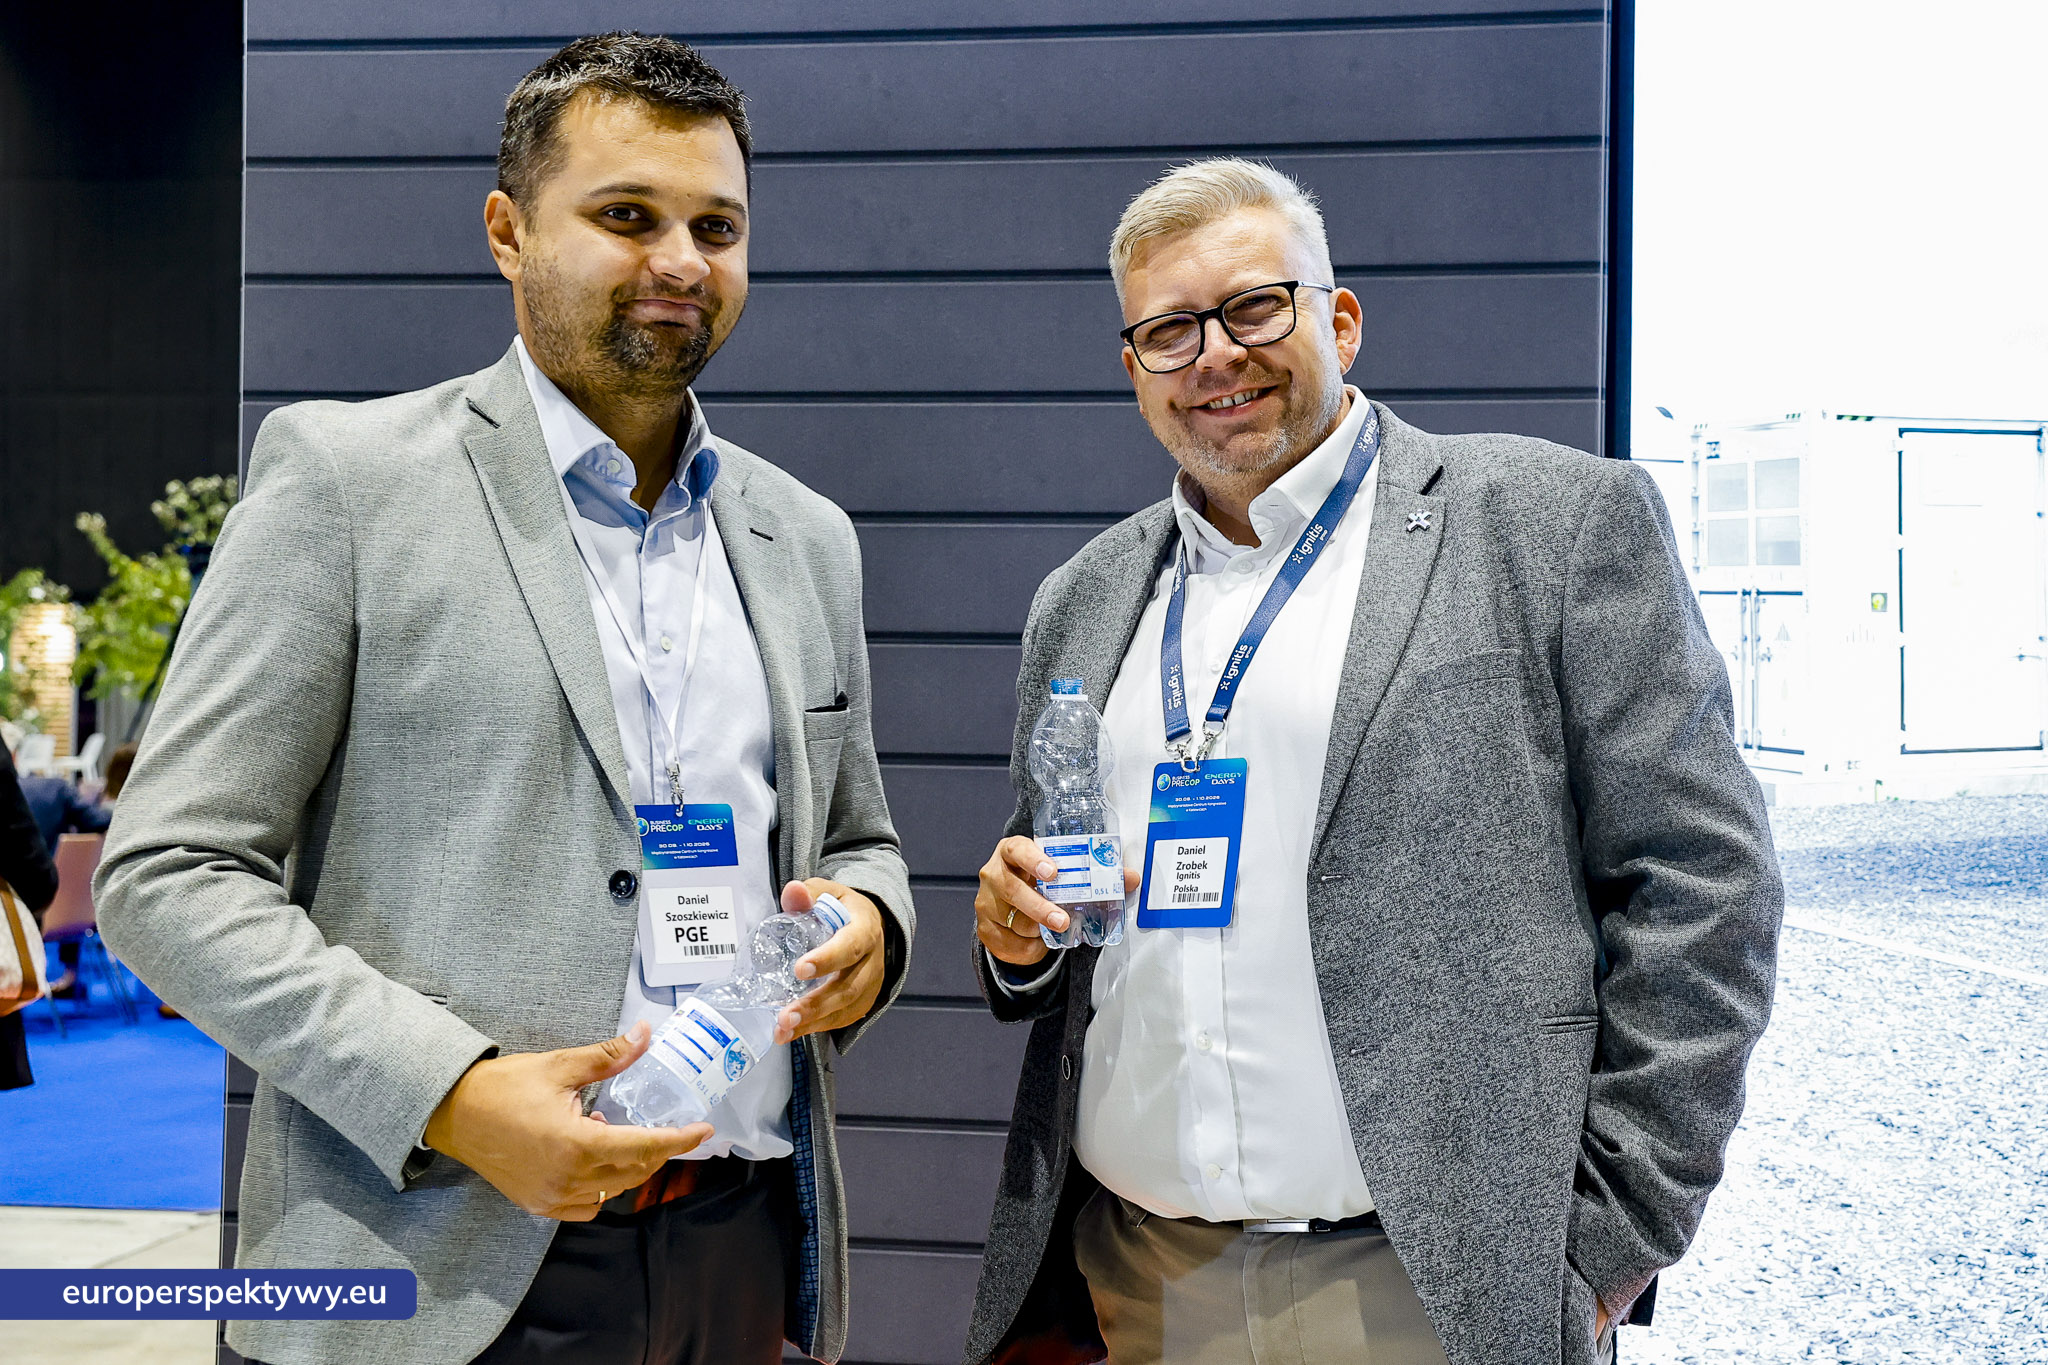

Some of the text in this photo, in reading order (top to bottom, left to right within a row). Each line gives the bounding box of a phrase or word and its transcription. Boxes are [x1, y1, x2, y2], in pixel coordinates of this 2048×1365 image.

[1360, 418, 1377, 444] ignitis
[1296, 524, 1324, 555] ignitis
[1224, 644, 1248, 680] ignitis
[1168, 673, 1184, 708] ignitis
[1204, 772, 1243, 780] ENERGY
[1171, 778, 1200, 787] PRECOP
[650, 824, 684, 832] PRECOP
[1177, 845, 1206, 856] Daniel
[1175, 860, 1208, 870] Zrobek
[1176, 871, 1201, 882] Ignitis
[1173, 884, 1199, 893] Polska
[677, 894, 709, 905] Daniel
[665, 909, 729, 922] Szoszkiewicz
[675, 926, 710, 943] PGE
